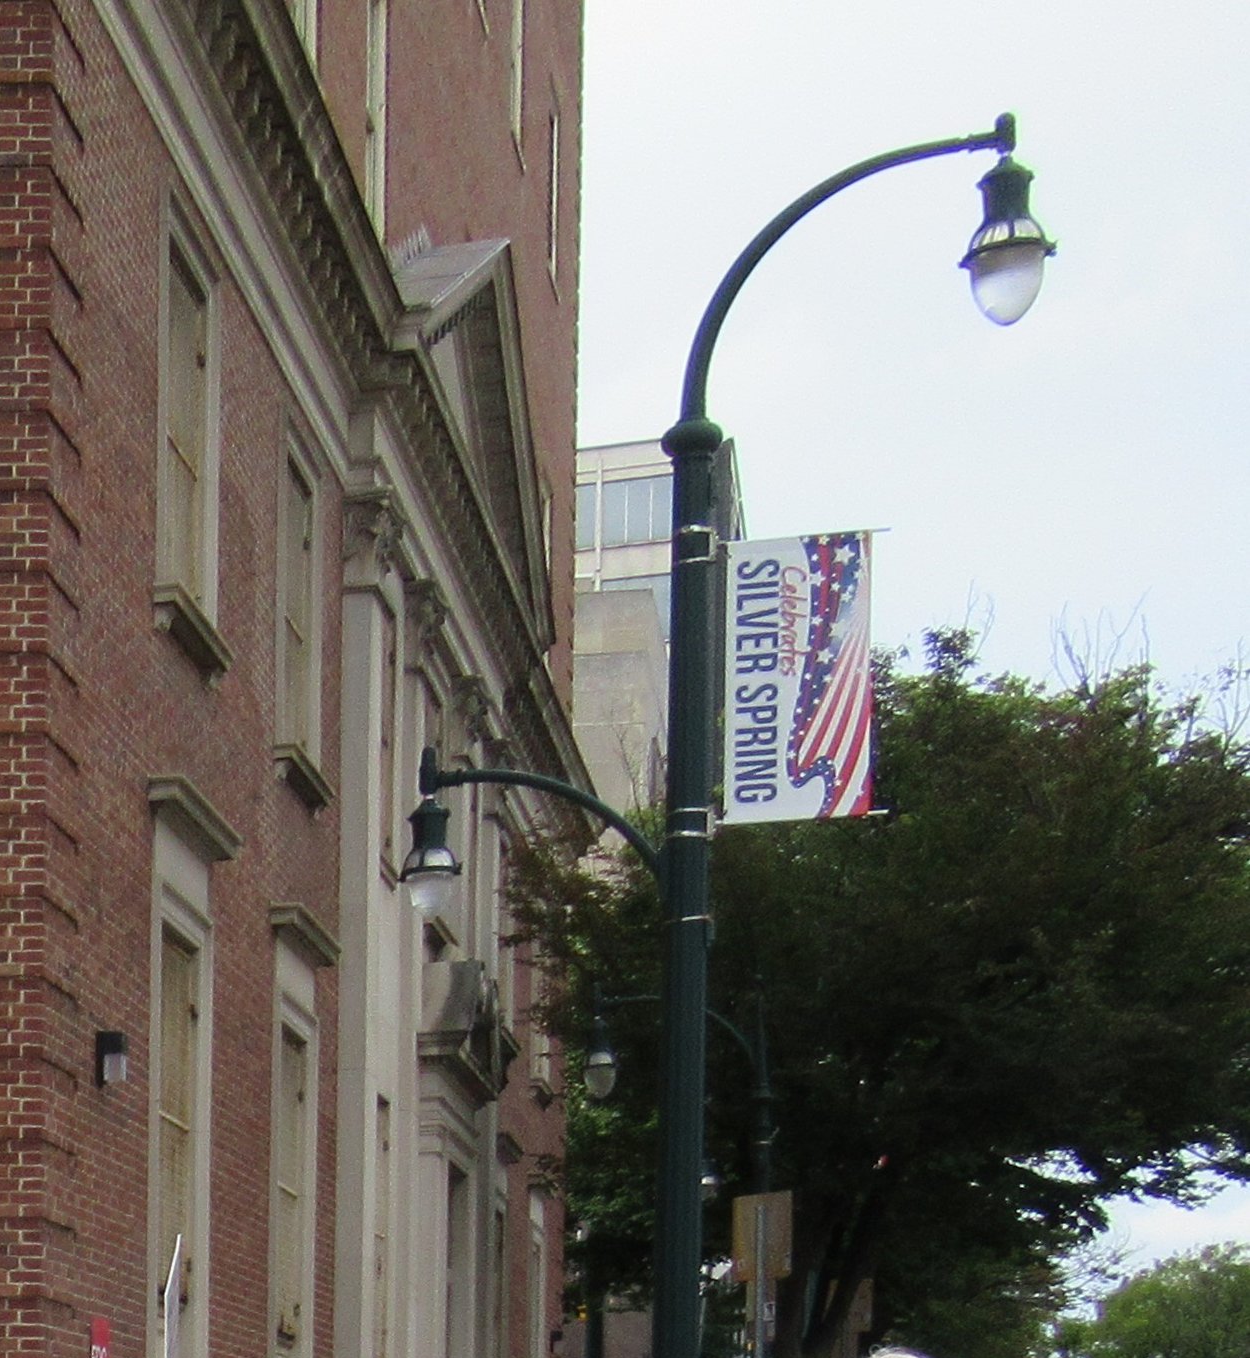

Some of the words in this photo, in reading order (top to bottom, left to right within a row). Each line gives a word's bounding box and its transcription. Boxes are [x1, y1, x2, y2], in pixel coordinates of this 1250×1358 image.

[735, 559, 780, 674] SILVER
[778, 566, 813, 677] Celebrates
[734, 683, 779, 803] SPRING
